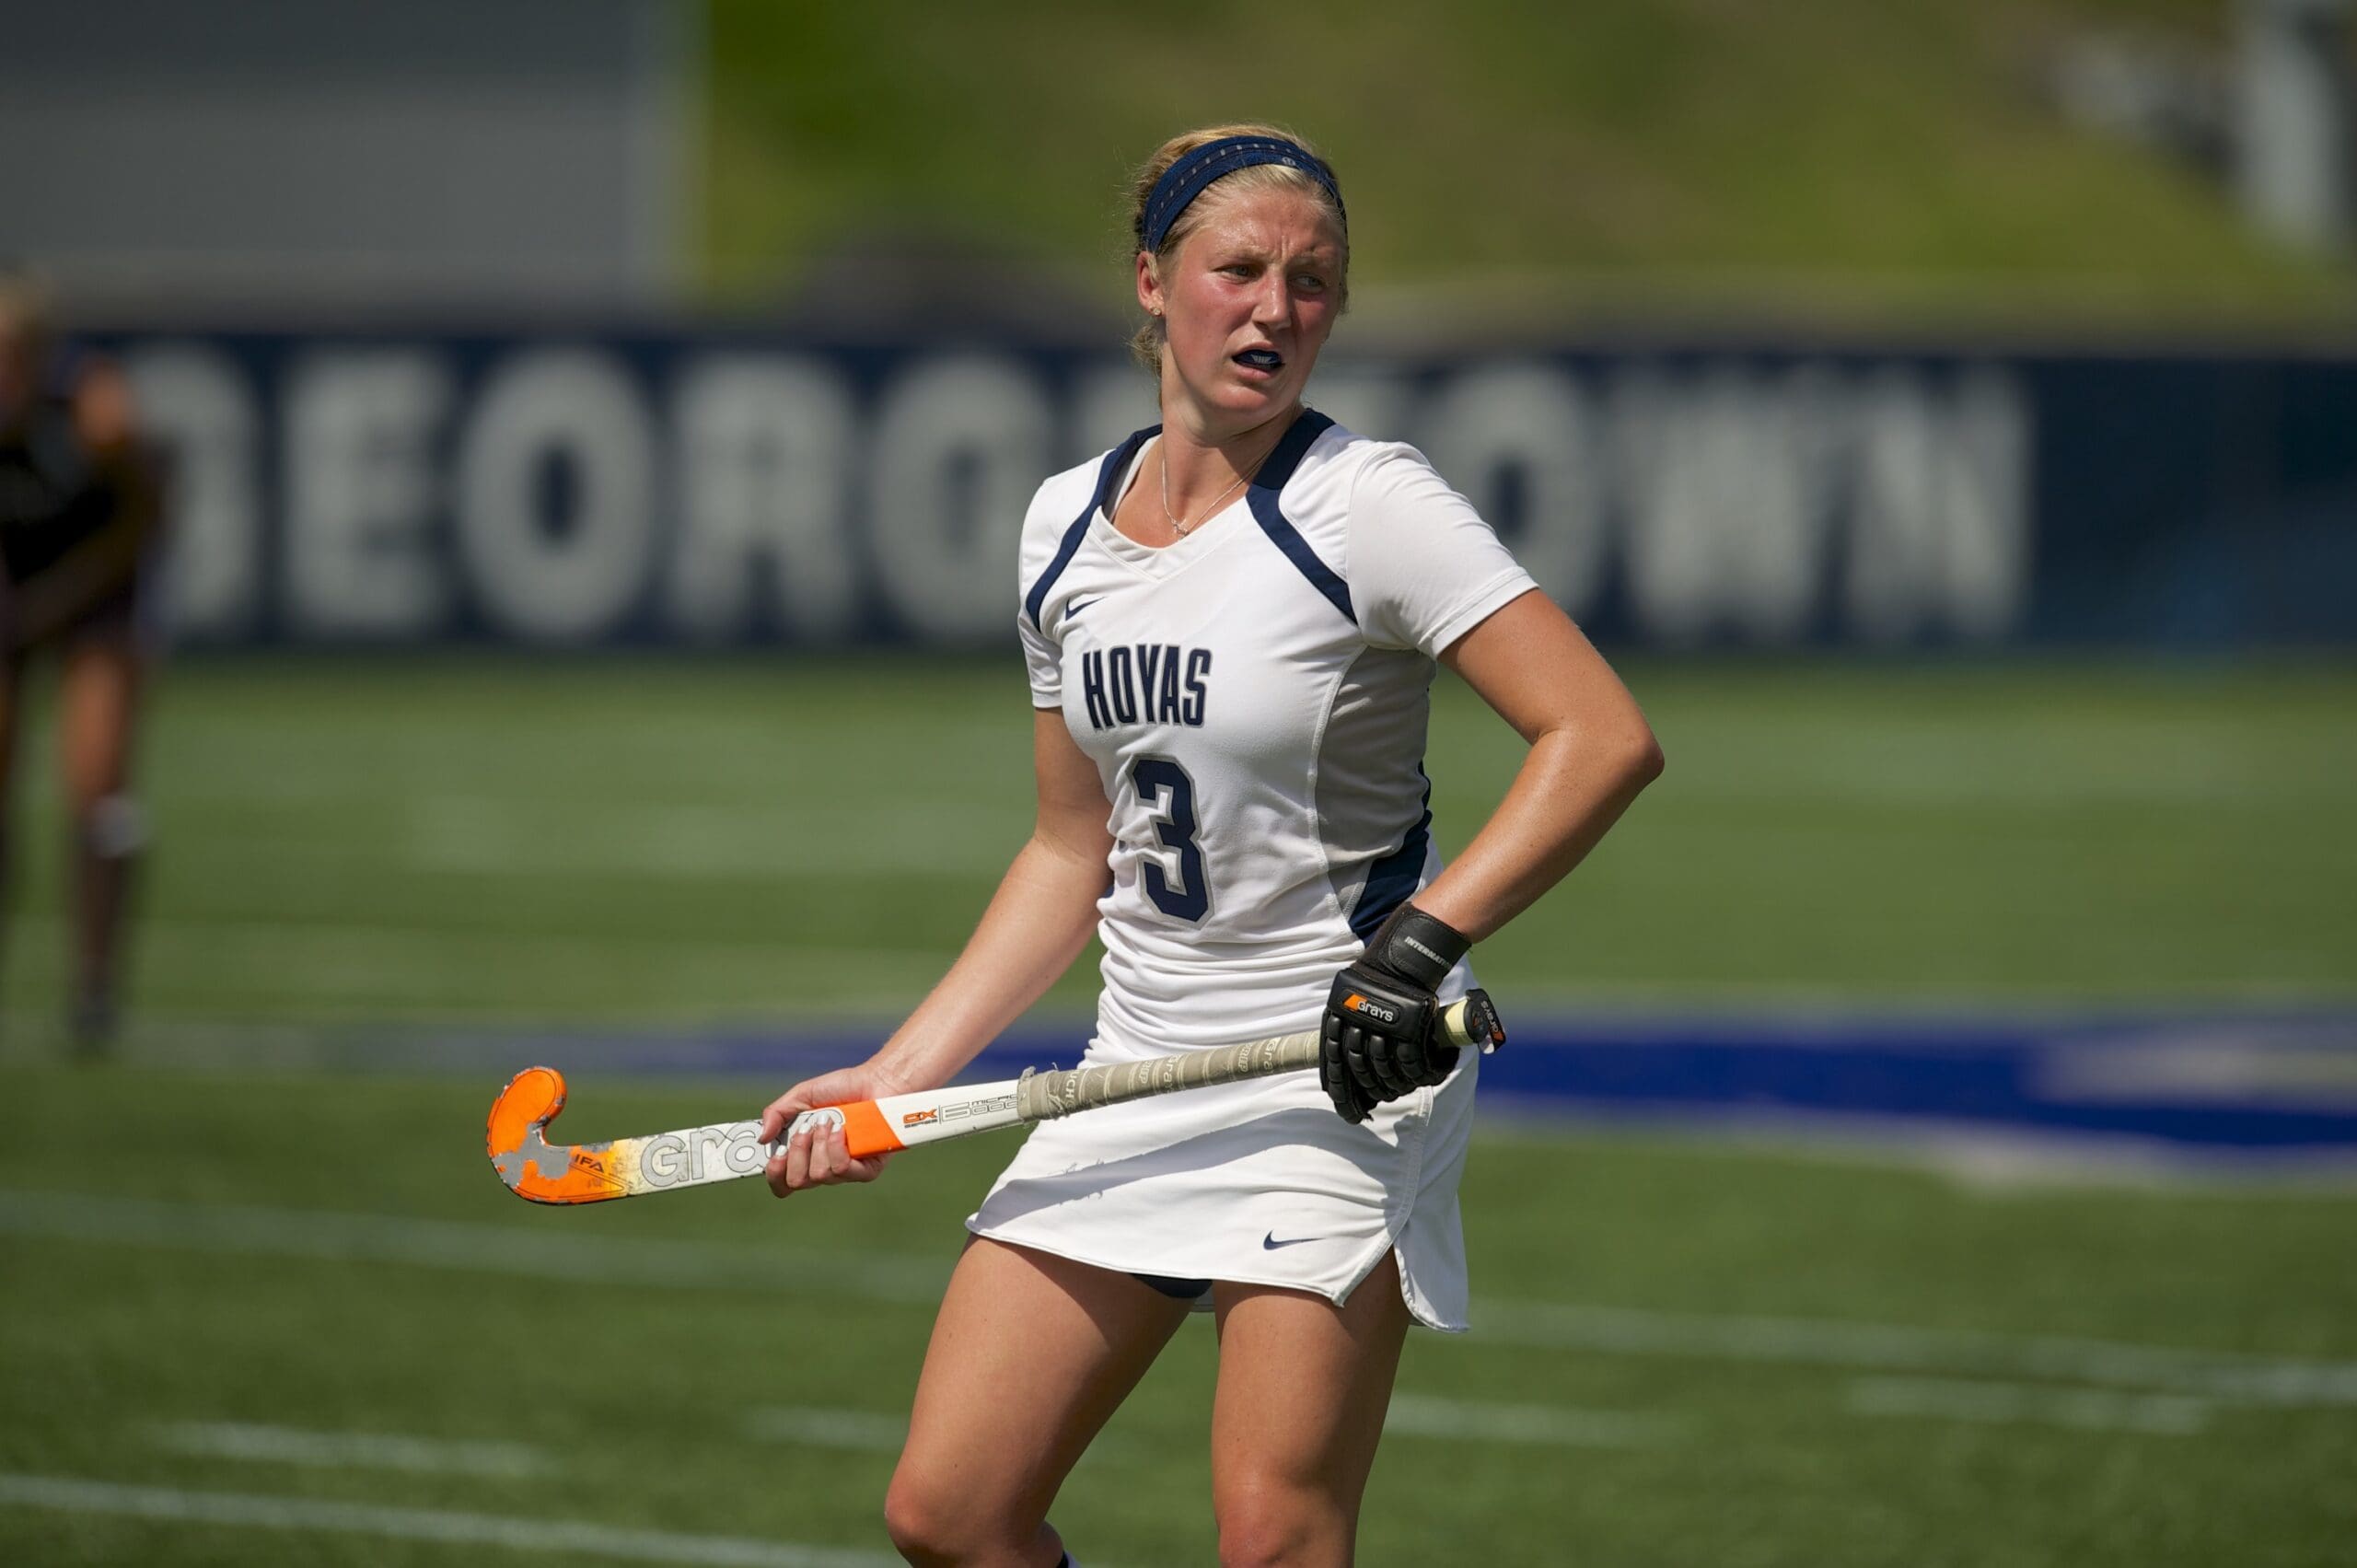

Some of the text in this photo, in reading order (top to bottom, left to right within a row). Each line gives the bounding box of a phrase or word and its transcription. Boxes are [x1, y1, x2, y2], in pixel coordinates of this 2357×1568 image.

[1083, 644, 1213, 730] HOYAS
[1125, 753, 1214, 930] 3
[1357, 1000, 1394, 1022] Grays
